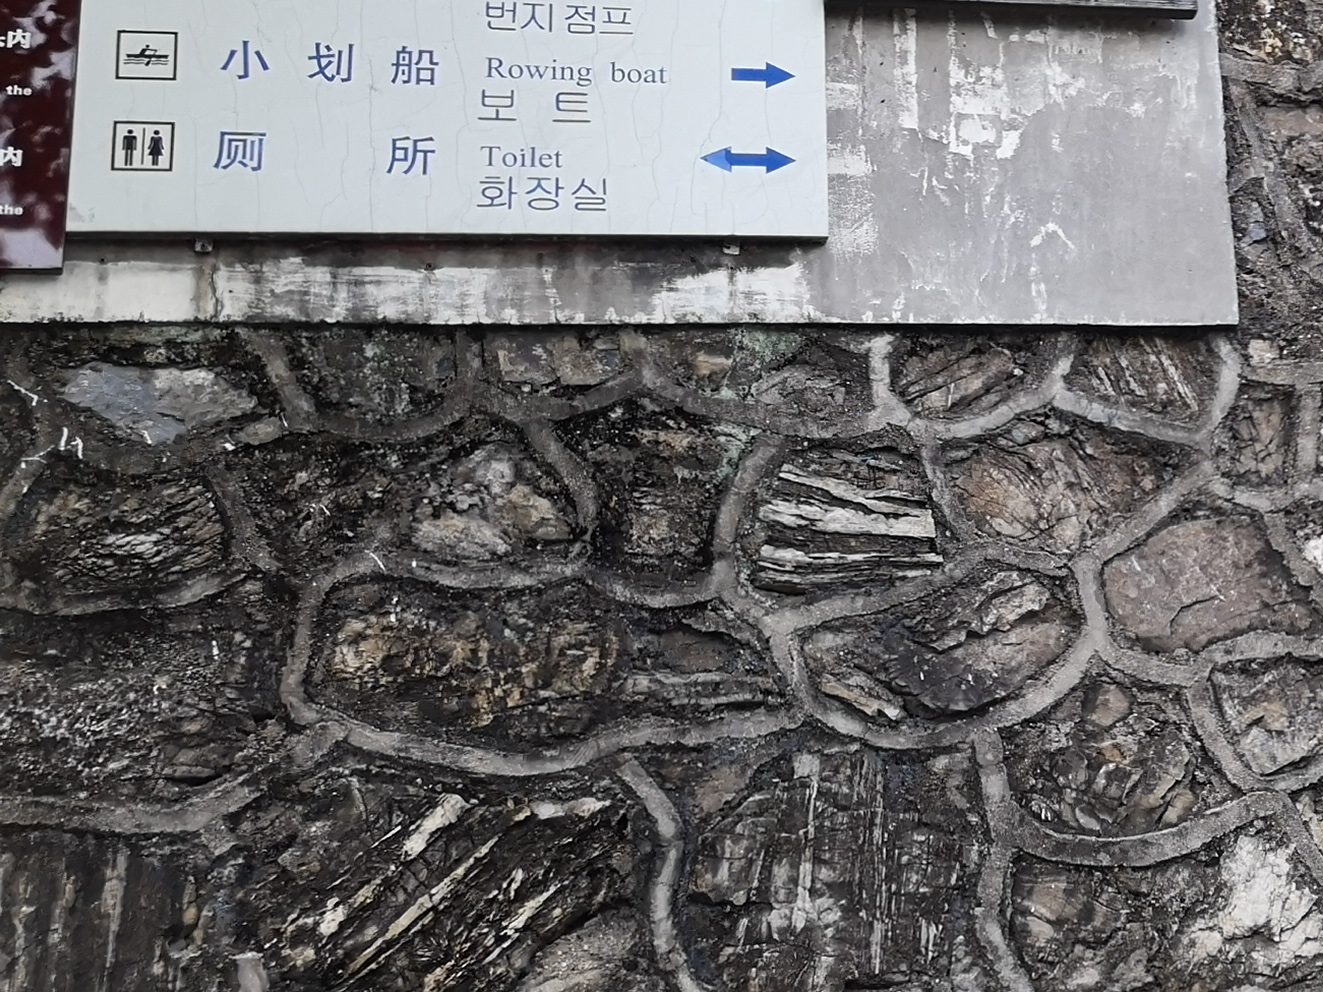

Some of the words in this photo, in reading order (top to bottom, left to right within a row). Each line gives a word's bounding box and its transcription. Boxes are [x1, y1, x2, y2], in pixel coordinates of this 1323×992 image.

[485, 1, 553, 33] 번지
[564, 4, 634, 35] 점프
[220, 40, 440, 86] 小划船
[485, 57, 593, 87] Rowing
[610, 61, 668, 84] boat
[6, 85, 33, 96] the
[480, 145, 563, 168] Toilet
[476, 176, 608, 212] 화장실
